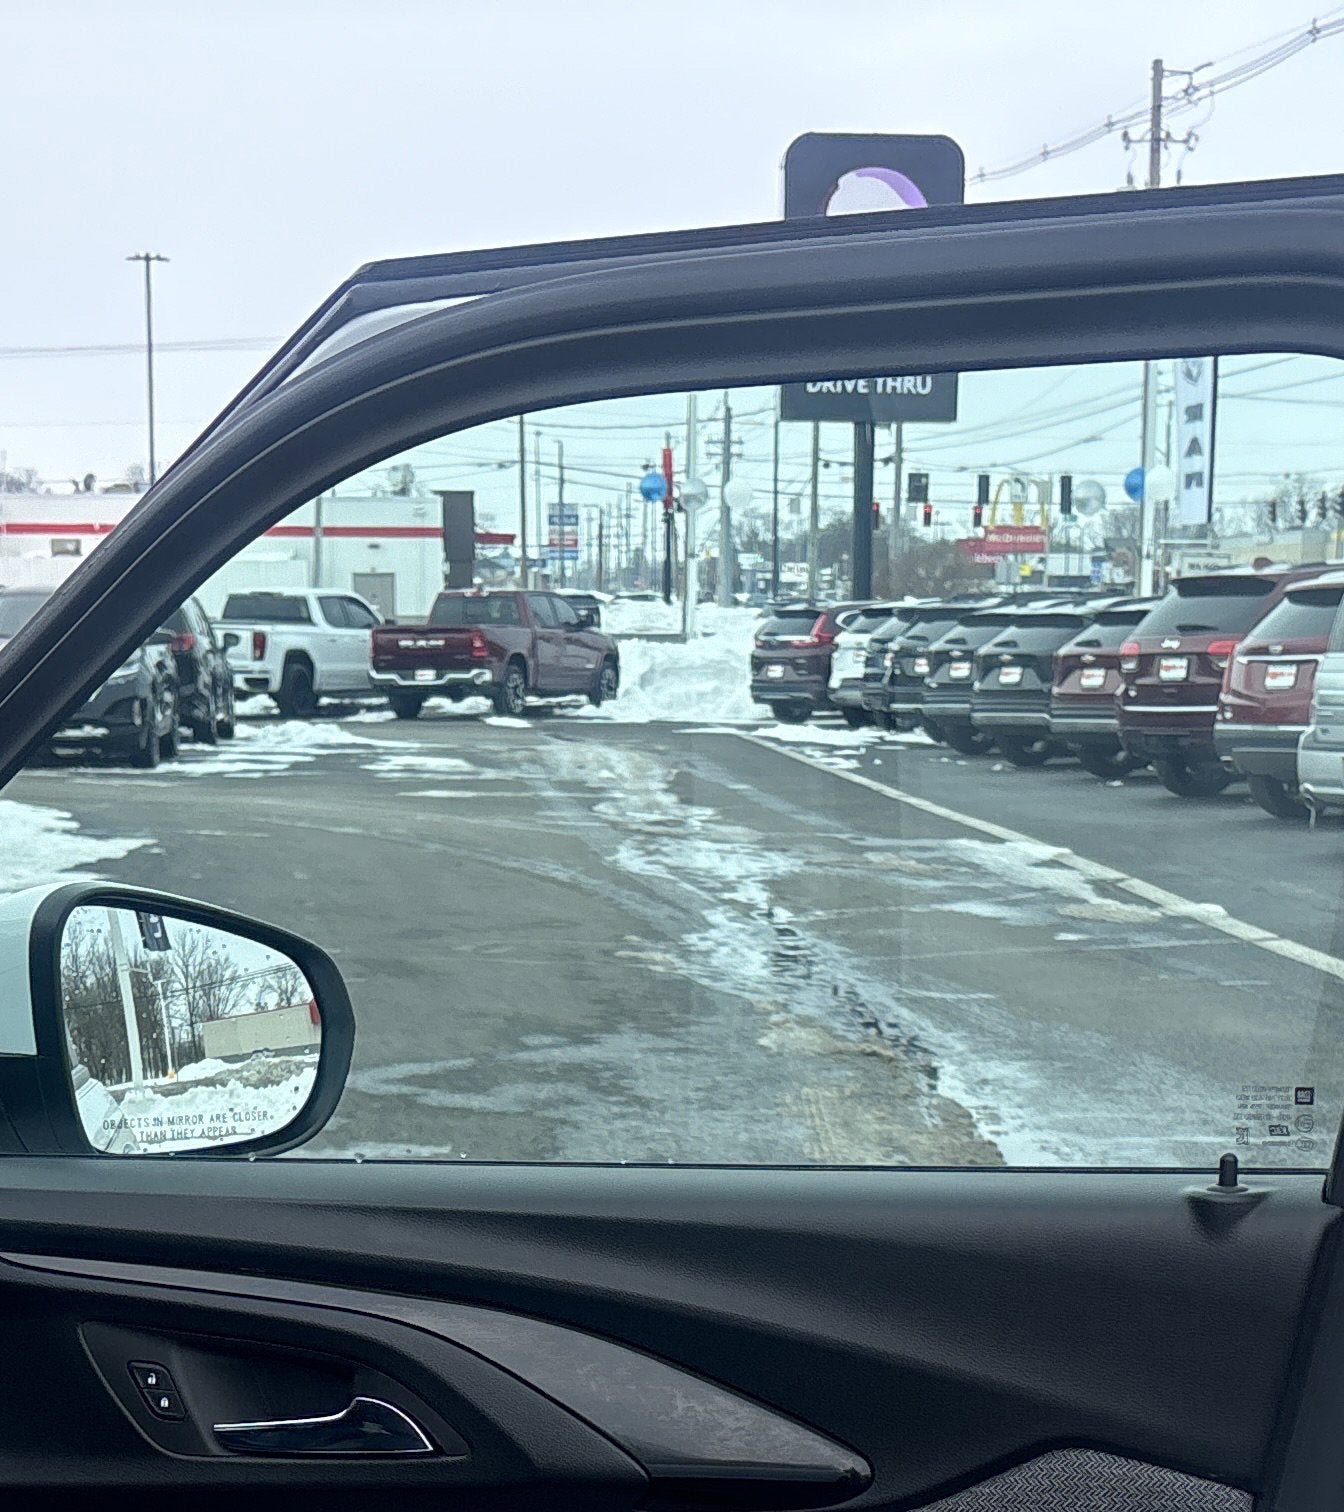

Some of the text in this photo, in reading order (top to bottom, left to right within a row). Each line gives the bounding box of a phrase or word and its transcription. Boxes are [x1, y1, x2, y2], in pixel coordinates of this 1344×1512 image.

[806, 375, 932, 395] DRIVE THRU
[103, 1117, 150, 1130] OBJECTS
[167, 1114, 204, 1126] MIRROR
[210, 1113, 228, 1124] ARE
[233, 1110, 269, 1122] CLOSER
[139, 1126, 237, 1141] THAN THEY APPEAR
